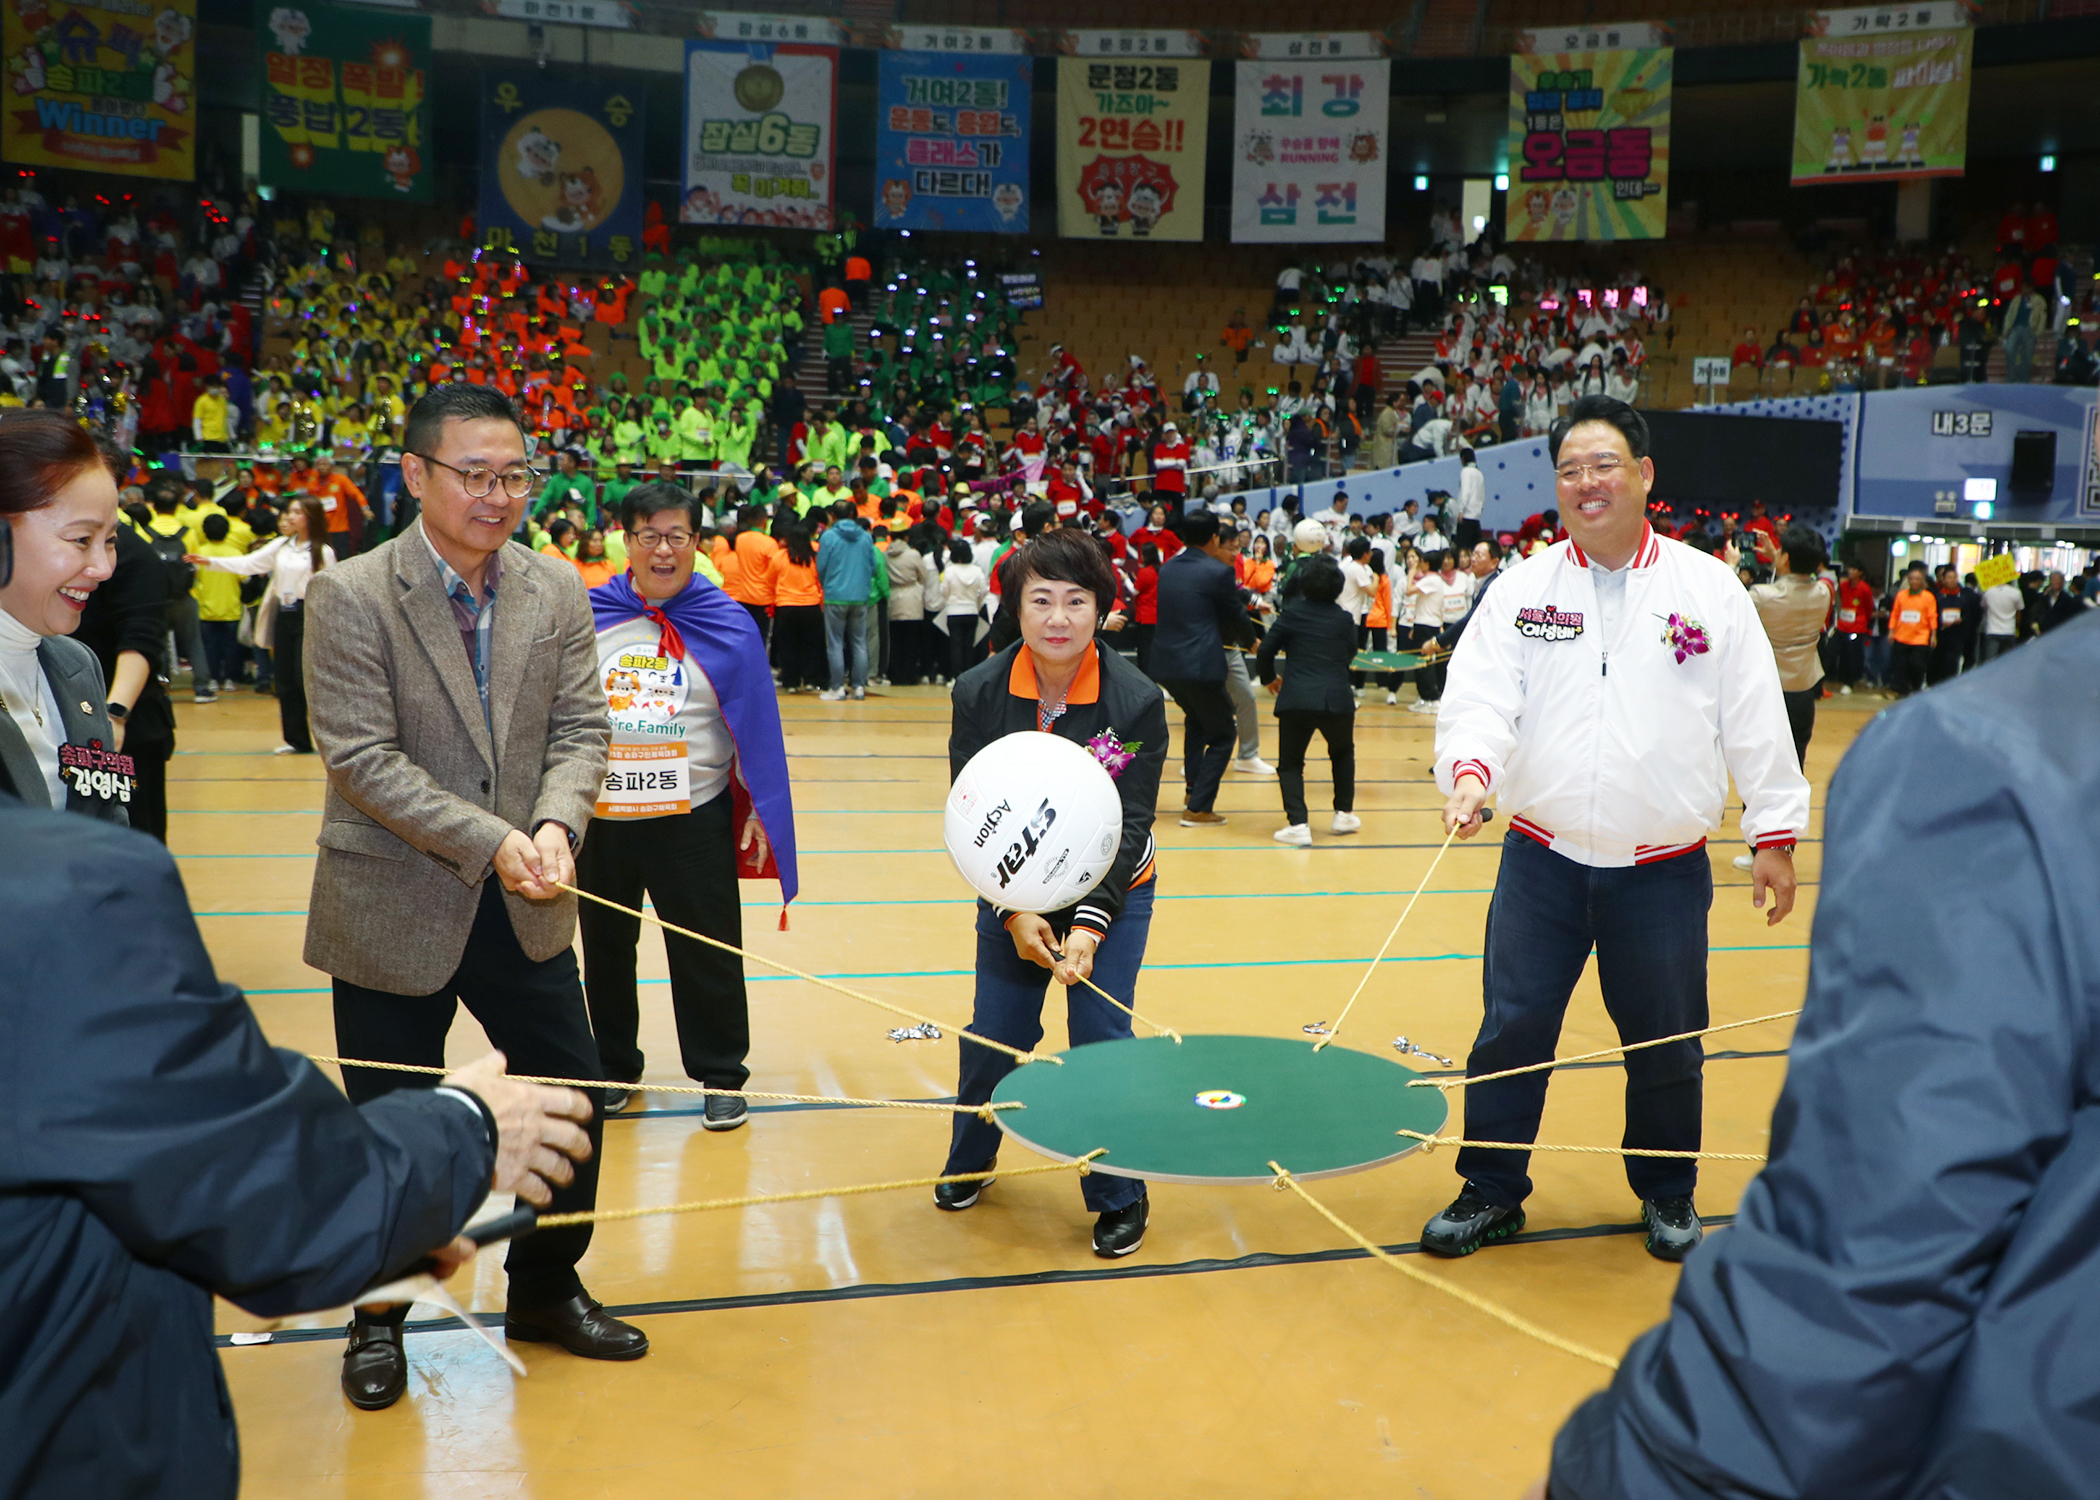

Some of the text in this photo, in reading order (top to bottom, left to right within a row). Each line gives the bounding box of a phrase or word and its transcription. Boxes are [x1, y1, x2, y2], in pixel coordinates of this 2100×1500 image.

[1852, 10, 1932, 30] 가락2동
[924, 34, 993, 50] 거여2동
[1100, 37, 1167, 51] 문정2동
[1565, 32, 1620, 48] 오금동
[1088, 64, 1179, 91] 문정2동
[1807, 62, 1888, 89] 가락2동
[902, 76, 1009, 108] 거여2동!
[1261, 74, 1365, 118] 최강
[35, 97, 167, 142] Winner
[700, 112, 821, 159] 잠실6동
[1078, 116, 1185, 152] 2연승!!
[907, 138, 1002, 167] 클래스가
[1280, 153, 1339, 163] RUNNING
[1521, 128, 1652, 181] 오금동
[1258, 182, 1357, 225] 삼전
[1933, 410, 1991, 436] 내3문
[1518, 607, 1583, 626] 서울시의원
[1522, 621, 1575, 641] 이성배
[619, 653, 669, 671] 송파2동
[637, 719, 686, 738] Family
[60, 743, 136, 776] 송파구의원
[624, 749, 678, 759] 송파구민체육대회
[69, 766, 131, 803] 김영심
[605, 769, 678, 791] 송파2동
[974, 799, 1012, 849] Action
